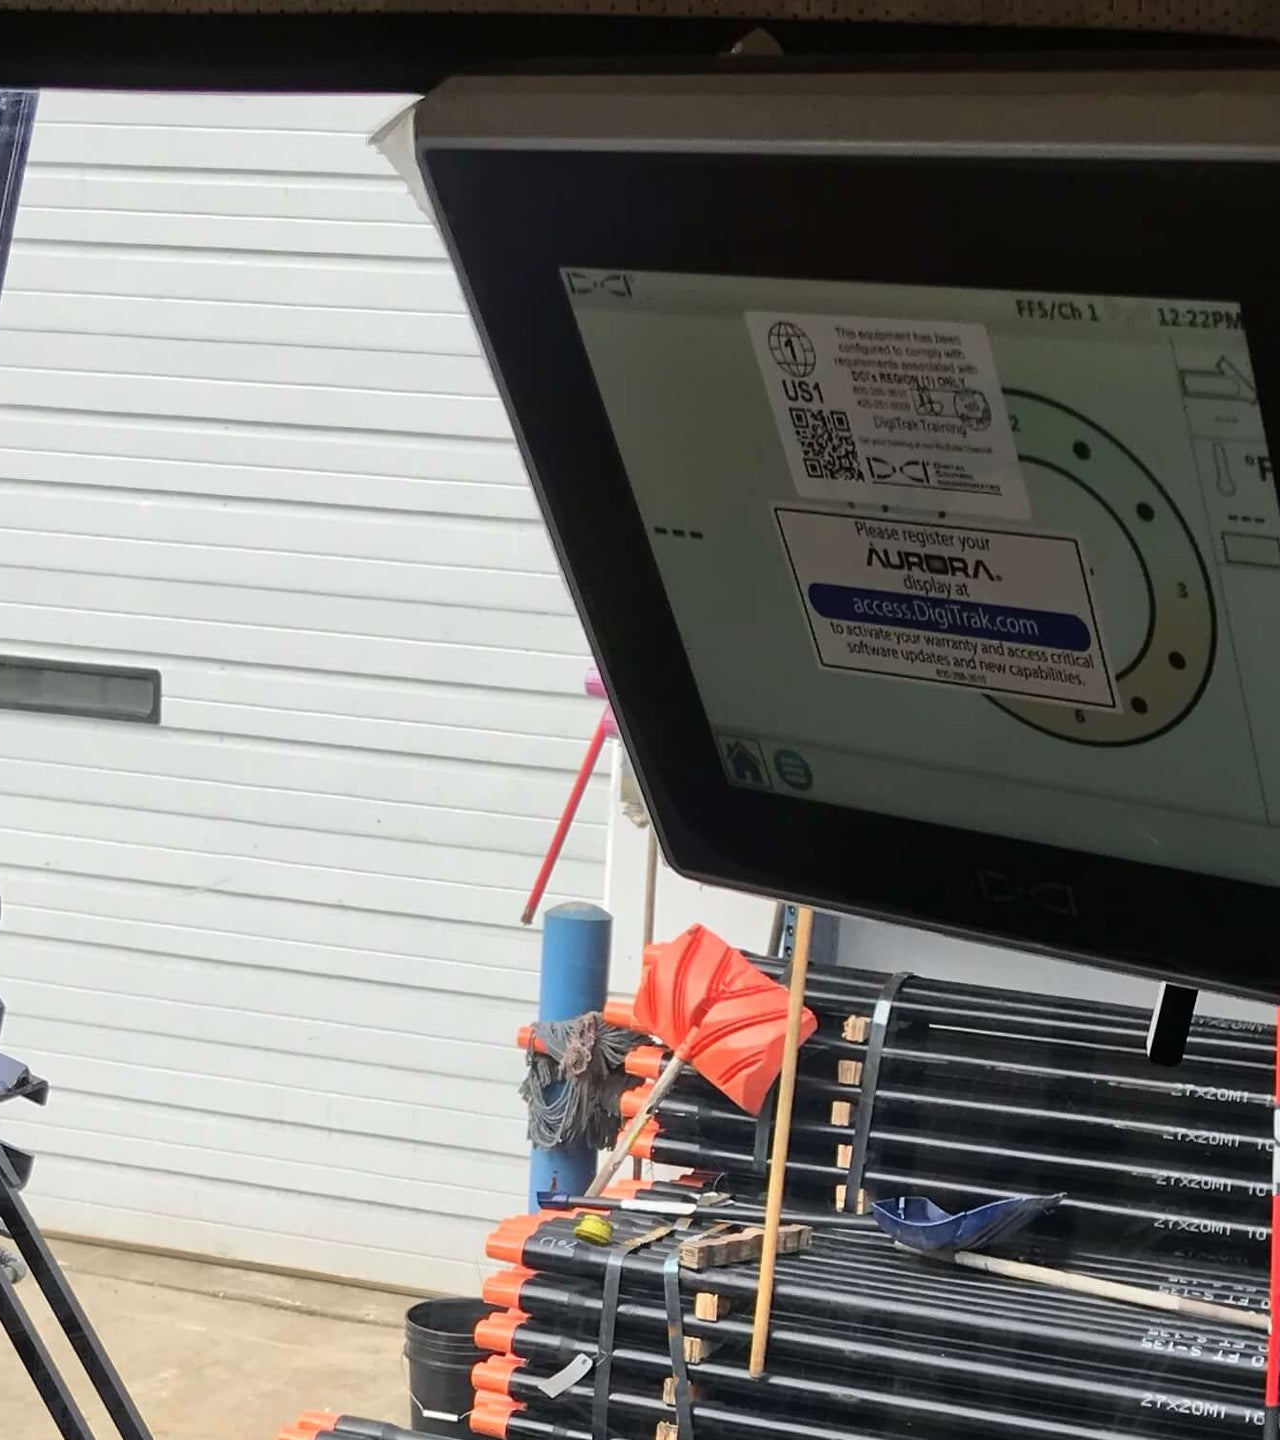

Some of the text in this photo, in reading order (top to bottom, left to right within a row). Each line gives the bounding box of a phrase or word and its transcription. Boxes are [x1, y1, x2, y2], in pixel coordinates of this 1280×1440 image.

[1088, 303, 1100, 322] 1
[784, 338, 797, 363] 1
[782, 379, 824, 404] US1
[879, 373, 917, 386] REGION
[873, 416, 967, 438] DigiTrak Training
[854, 520, 990, 552] Please register your
[866, 546, 995, 582] AURORA
[904, 575, 970, 598] display at
[852, 596, 1040, 637] access.DigiTrak.com
[830, 621, 1095, 670] to activate your warranty and access critical
[847, 640, 1086, 688] software updates and new capabilities.
